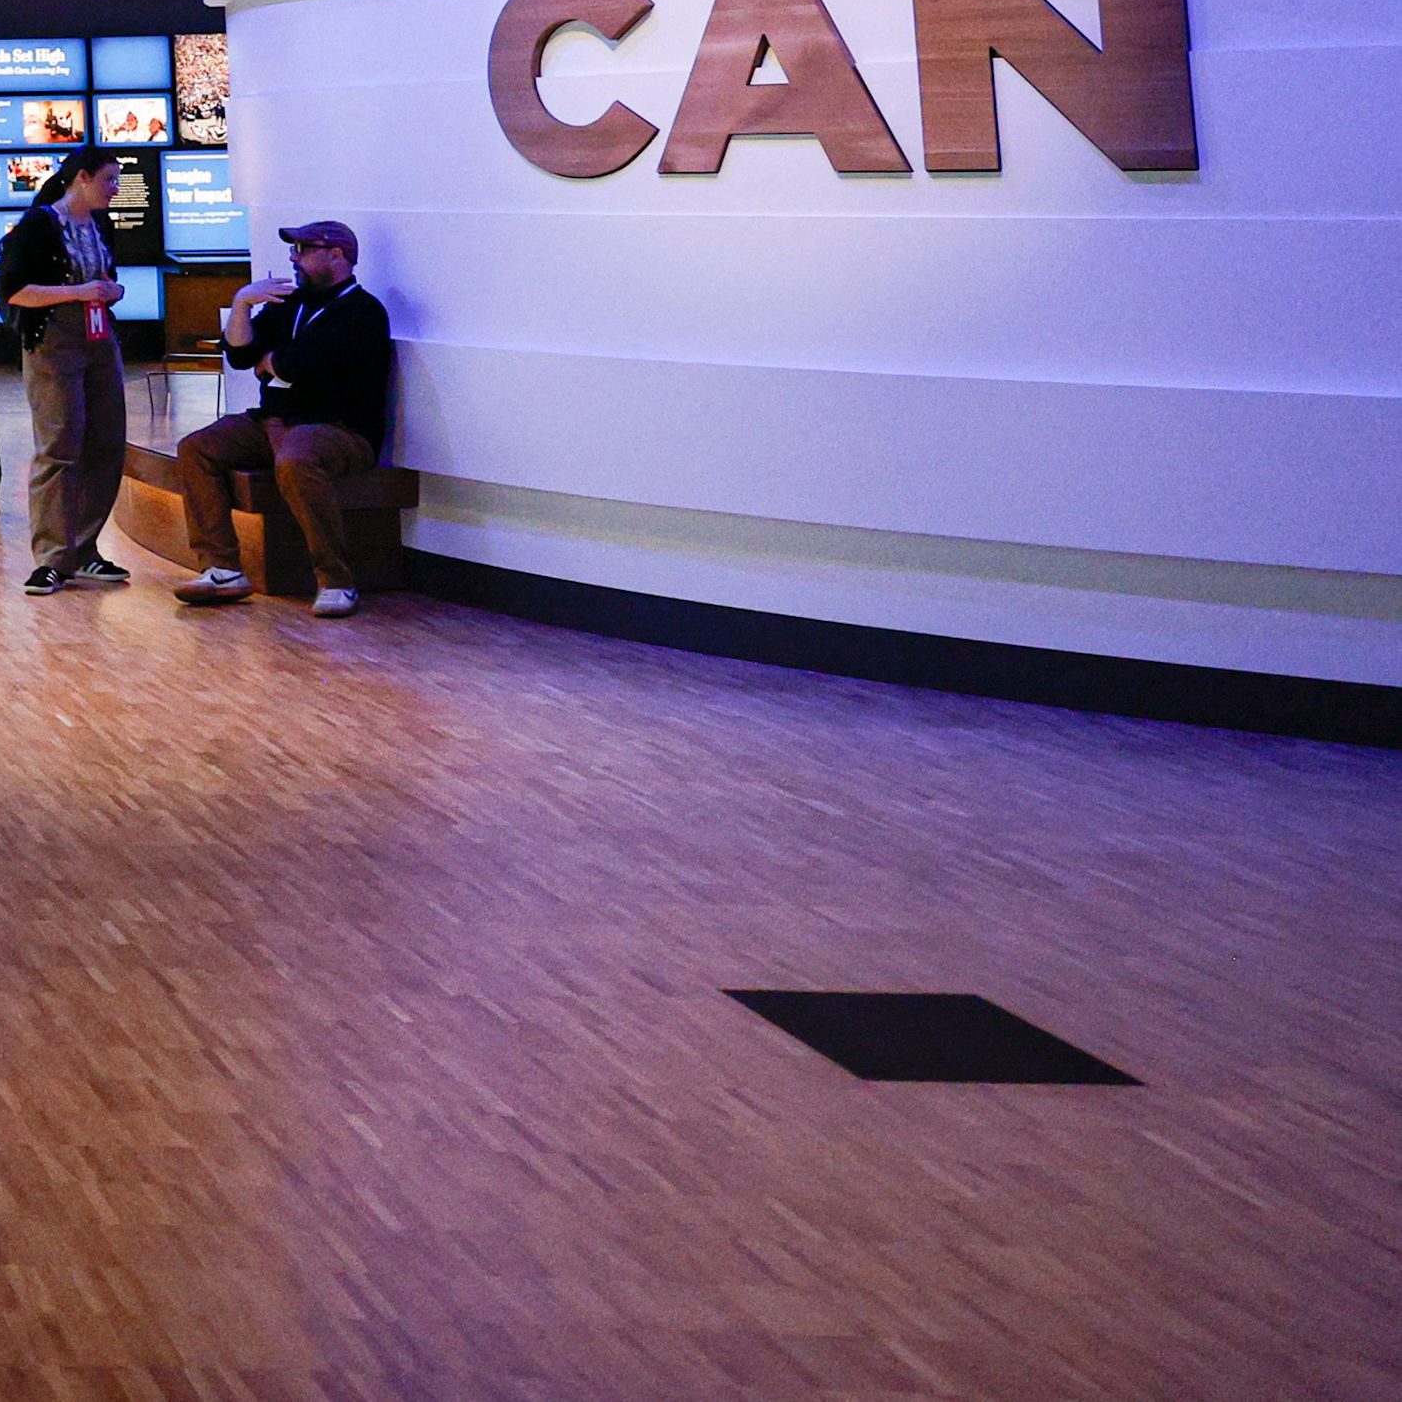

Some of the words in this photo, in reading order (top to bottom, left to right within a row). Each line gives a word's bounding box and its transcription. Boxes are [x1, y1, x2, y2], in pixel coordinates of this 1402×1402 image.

[13, 49, 33, 62] Set
[36, 48, 65, 66] High
[166, 169, 212, 186] Imagine
[167, 188, 193, 203] Your
